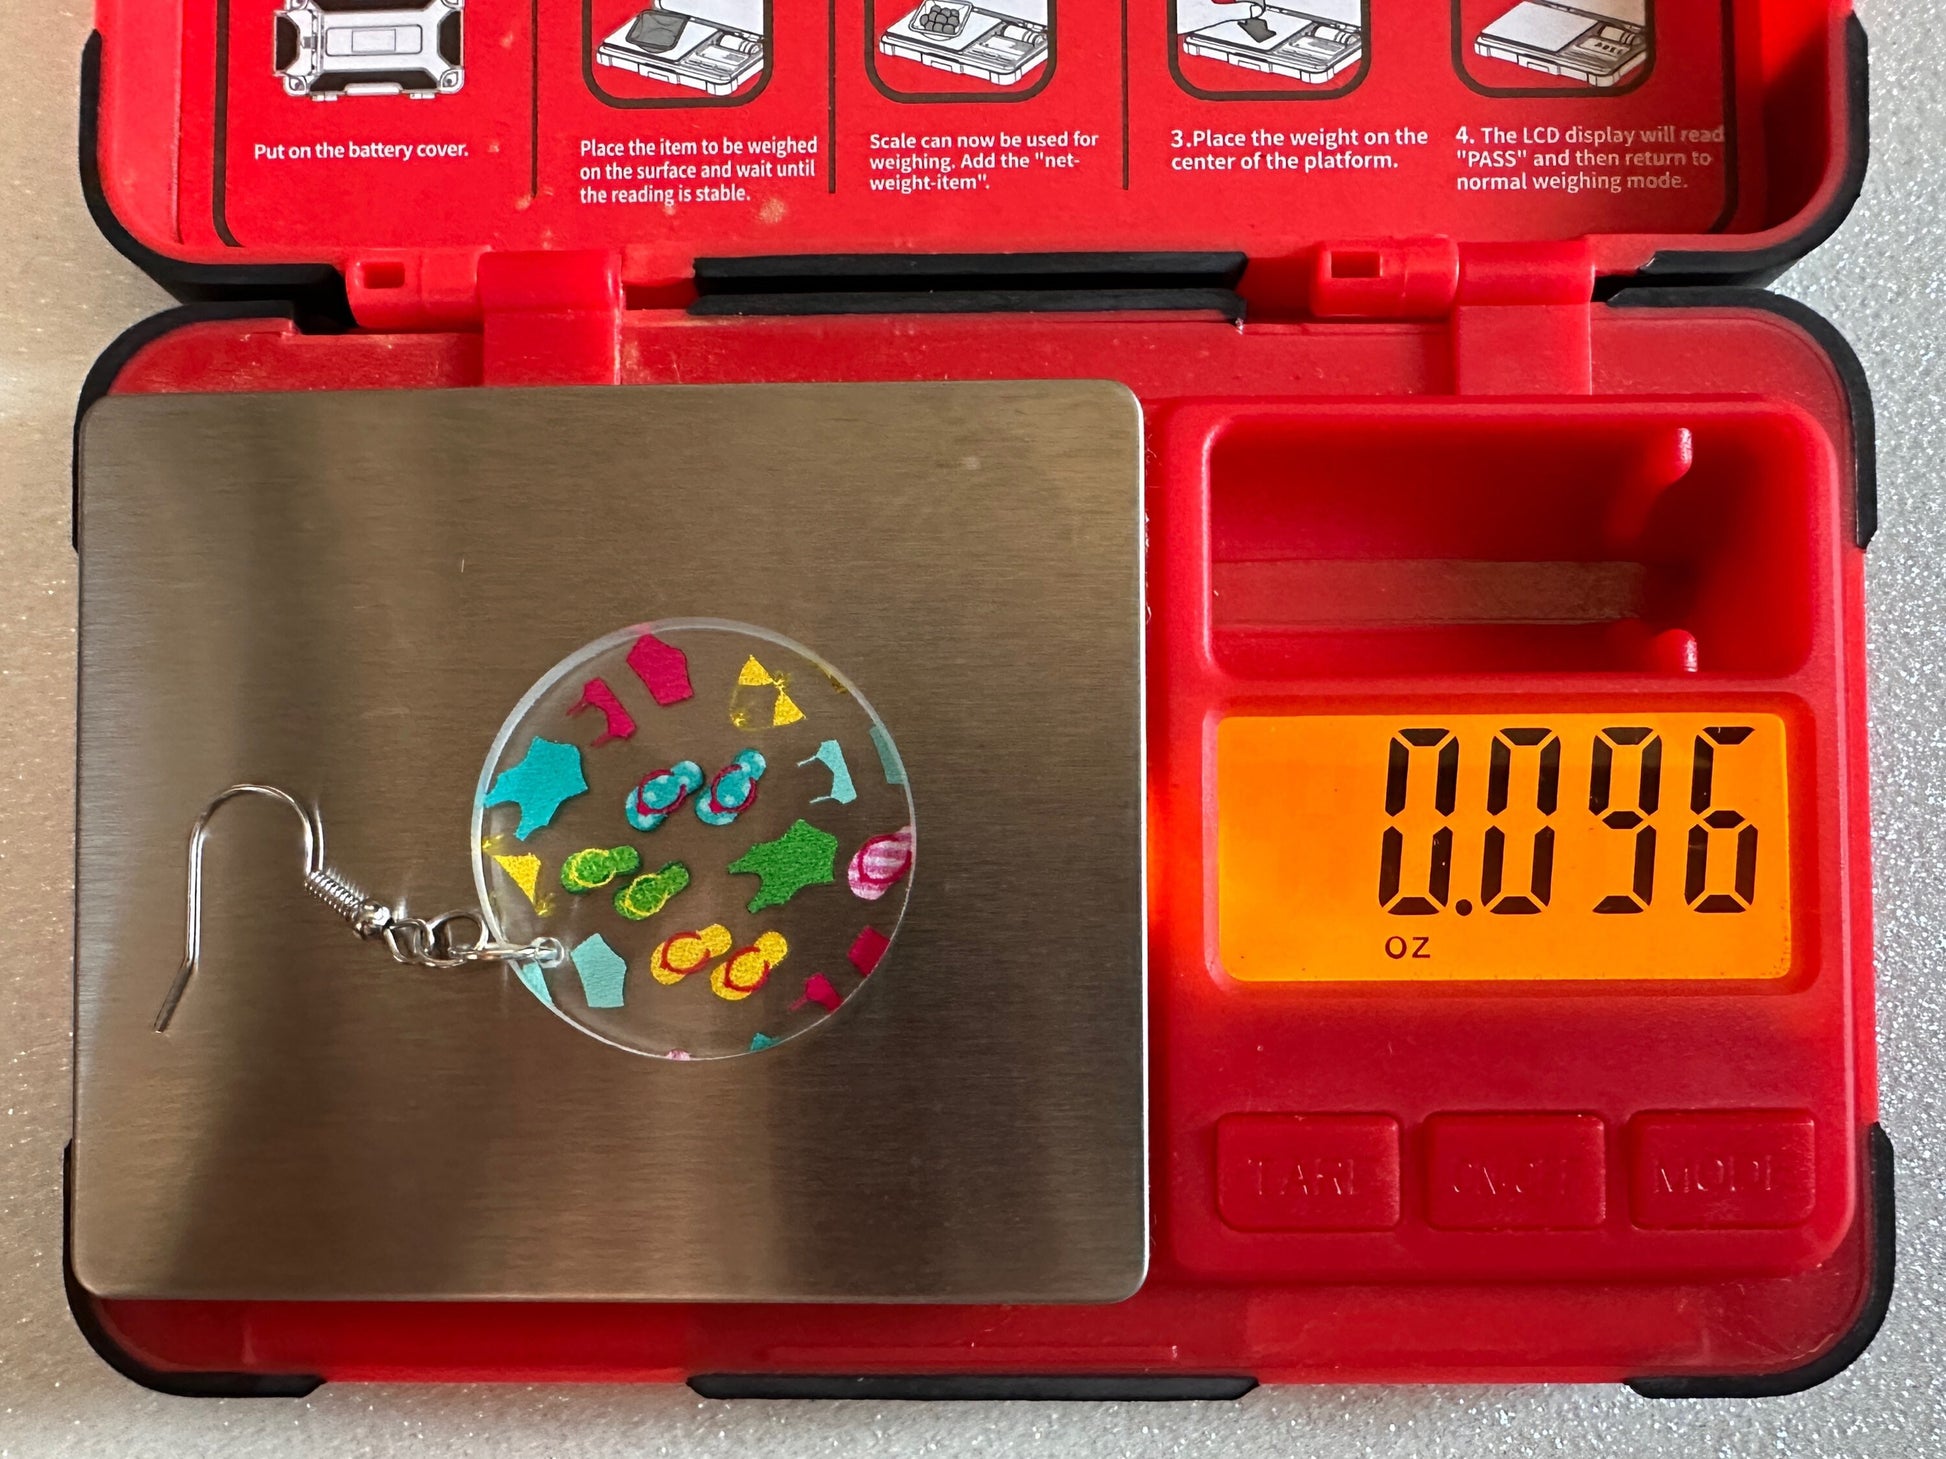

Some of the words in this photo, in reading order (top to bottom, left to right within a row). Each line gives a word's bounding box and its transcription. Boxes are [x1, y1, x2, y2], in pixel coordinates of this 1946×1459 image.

[580, 139, 624, 156] Place
[628, 138, 655, 156] the
[660, 138, 697, 155] item
[702, 140, 718, 154] to
[723, 137, 743, 154] be
[747, 135, 818, 157] weighed
[869, 133, 916, 149] Scale
[921, 135, 951, 148] can
[957, 135, 995, 148] now
[1000, 132, 1022, 147] be
[1026, 131, 1068, 147] used
[1073, 130, 1098, 146] for
[1170, 129, 1246, 148] 3.Place
[1251, 129, 1285, 146] the
[1289, 128, 1358, 150] weight
[1363, 131, 1389, 145] on
[1394, 127, 1428, 145] the
[1456, 126, 1475, 144] 4.
[1480, 126, 1517, 144] The
[1523, 127, 1560, 144] LCD
[1565, 126, 1635, 146] display
[1640, 126, 1676, 143] will
[1680, 125, 1725, 142] read
[254, 144, 284, 160] Put
[288, 146, 311, 159] on
[315, 142, 344, 158] the
[348, 142, 413, 161] battery
[416, 143, 469, 157] cover.
[1171, 154, 1235, 170] center
[1240, 151, 1261, 169] of
[1266, 152, 1298, 169] the
[1304, 151, 1398, 173] platform.
[1456, 150, 1527, 168] "PASS"
[1533, 149, 1570, 166] and
[1575, 149, 1620, 166] then
[1625, 150, 1686, 166] return
[1692, 150, 1712, 165] to
[580, 166, 601, 179] on
[605, 162, 632, 179] the
[637, 161, 696, 179] surface
[701, 161, 732, 178] and
[736, 161, 773, 177] wait
[776, 159, 815, 177] until
[869, 154, 955, 173] weighing.
[960, 153, 995, 169] Add
[1000, 152, 1030, 168] the
[1035, 152, 1080, 167] "net-
[869, 174, 990, 194] weight-item".
[1456, 172, 1528, 190] normal
[1532, 172, 1622, 193] weighing
[1626, 172, 1688, 188] mode.
[580, 186, 608, 203] the
[611, 185, 674, 206] reading
[678, 185, 691, 202] is
[695, 184, 751, 202] stable.
[1378, 726, 1758, 915] 0.096
